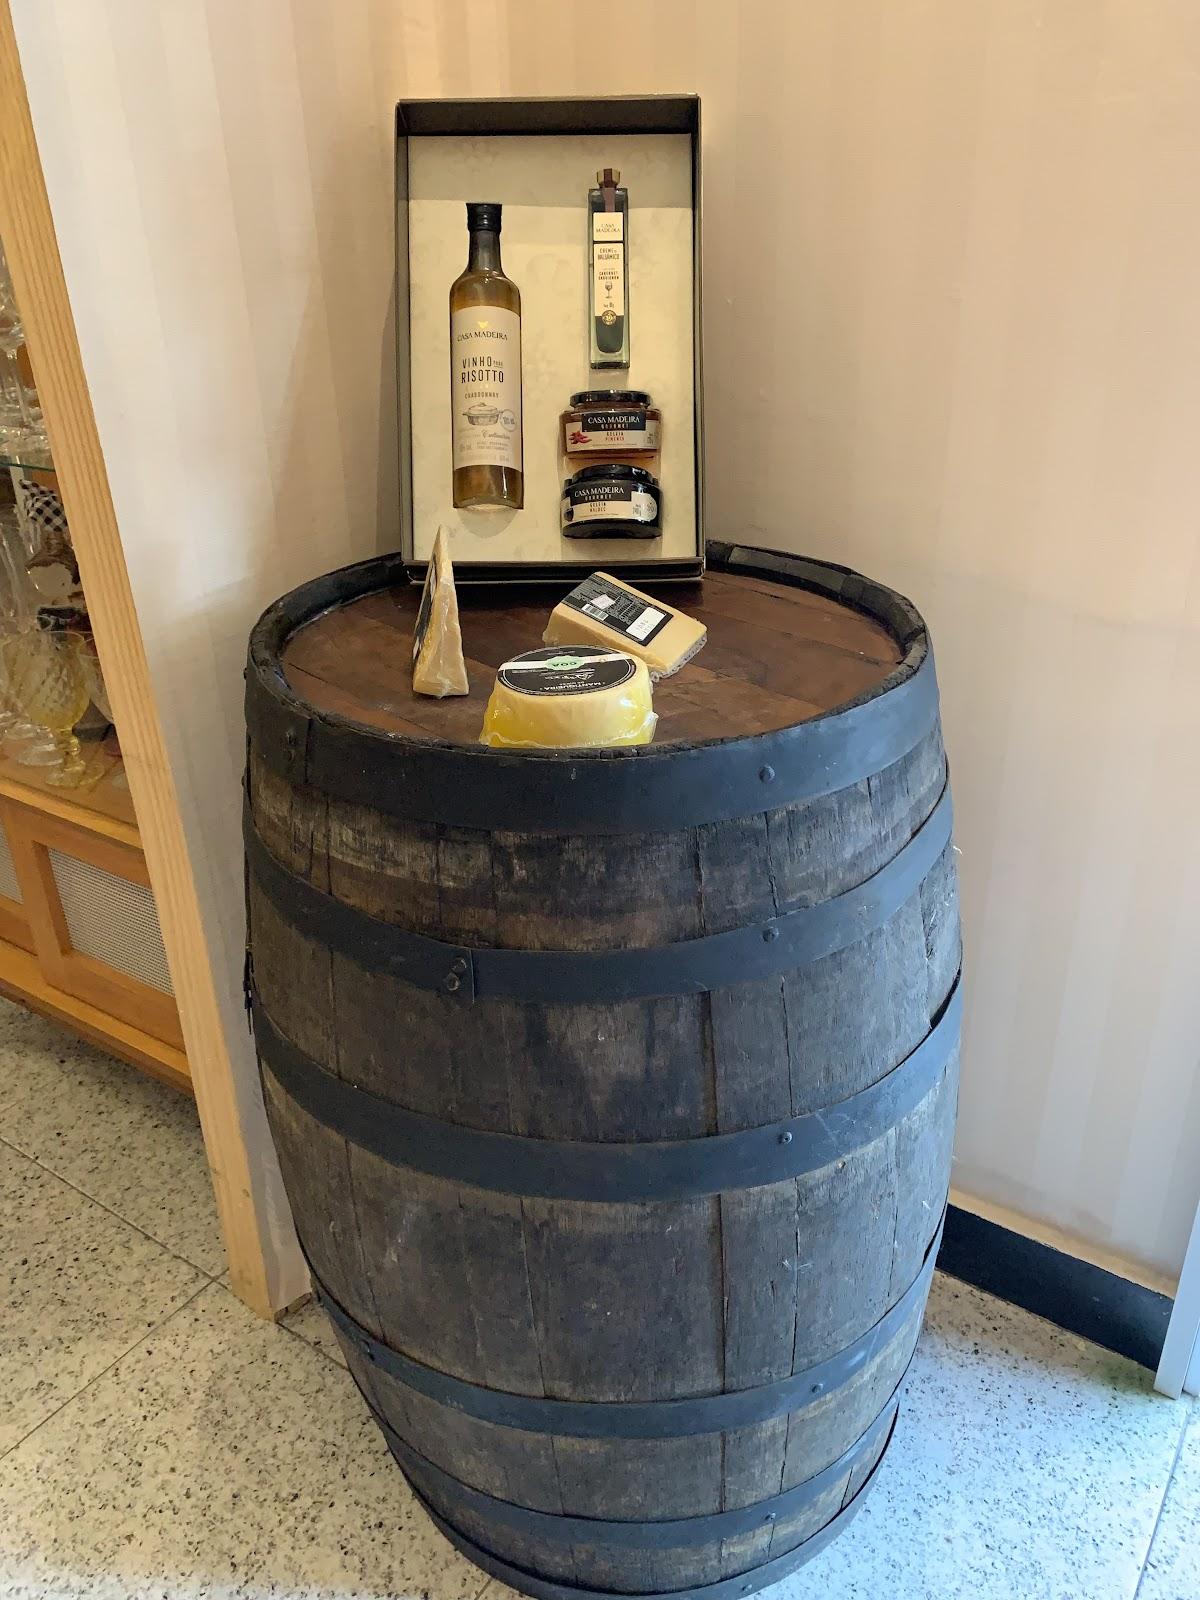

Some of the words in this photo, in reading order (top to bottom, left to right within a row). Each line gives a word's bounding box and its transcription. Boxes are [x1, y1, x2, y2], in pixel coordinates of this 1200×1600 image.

[457, 332, 472, 342] CASA
[474, 331, 508, 340] MADEIRA
[462, 355, 492, 369] VINHO
[461, 369, 504, 384] RISOTTO
[587, 416, 606, 424] CASA
[607, 415, 640, 424] MADEIRA
[574, 490, 590, 498] CASA
[591, 486, 625, 495] MADEIRA
